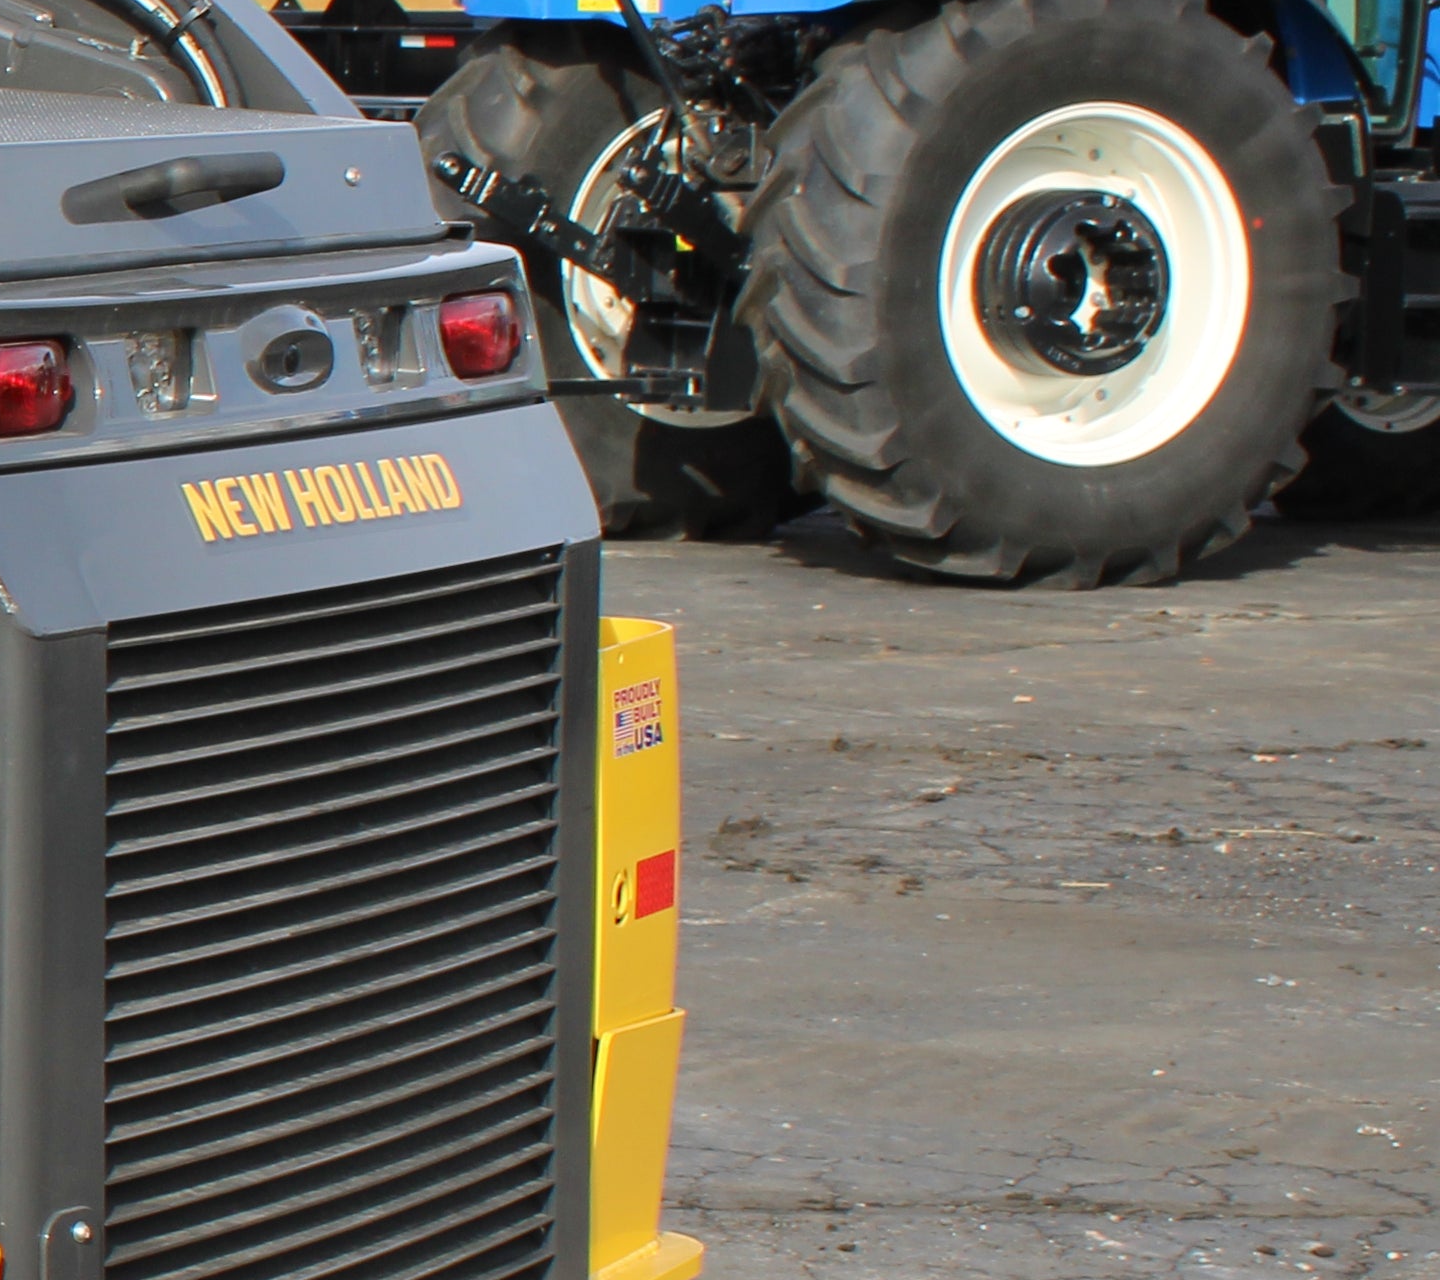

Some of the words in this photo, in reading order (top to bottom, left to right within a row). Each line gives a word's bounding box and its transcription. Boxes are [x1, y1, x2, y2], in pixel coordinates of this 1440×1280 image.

[181, 472, 293, 543] NEW
[283, 453, 464, 528] HOLLAND
[613, 678, 662, 709] PROUDLY
[633, 700, 663, 723] BUILT
[634, 722, 663, 751] USA
